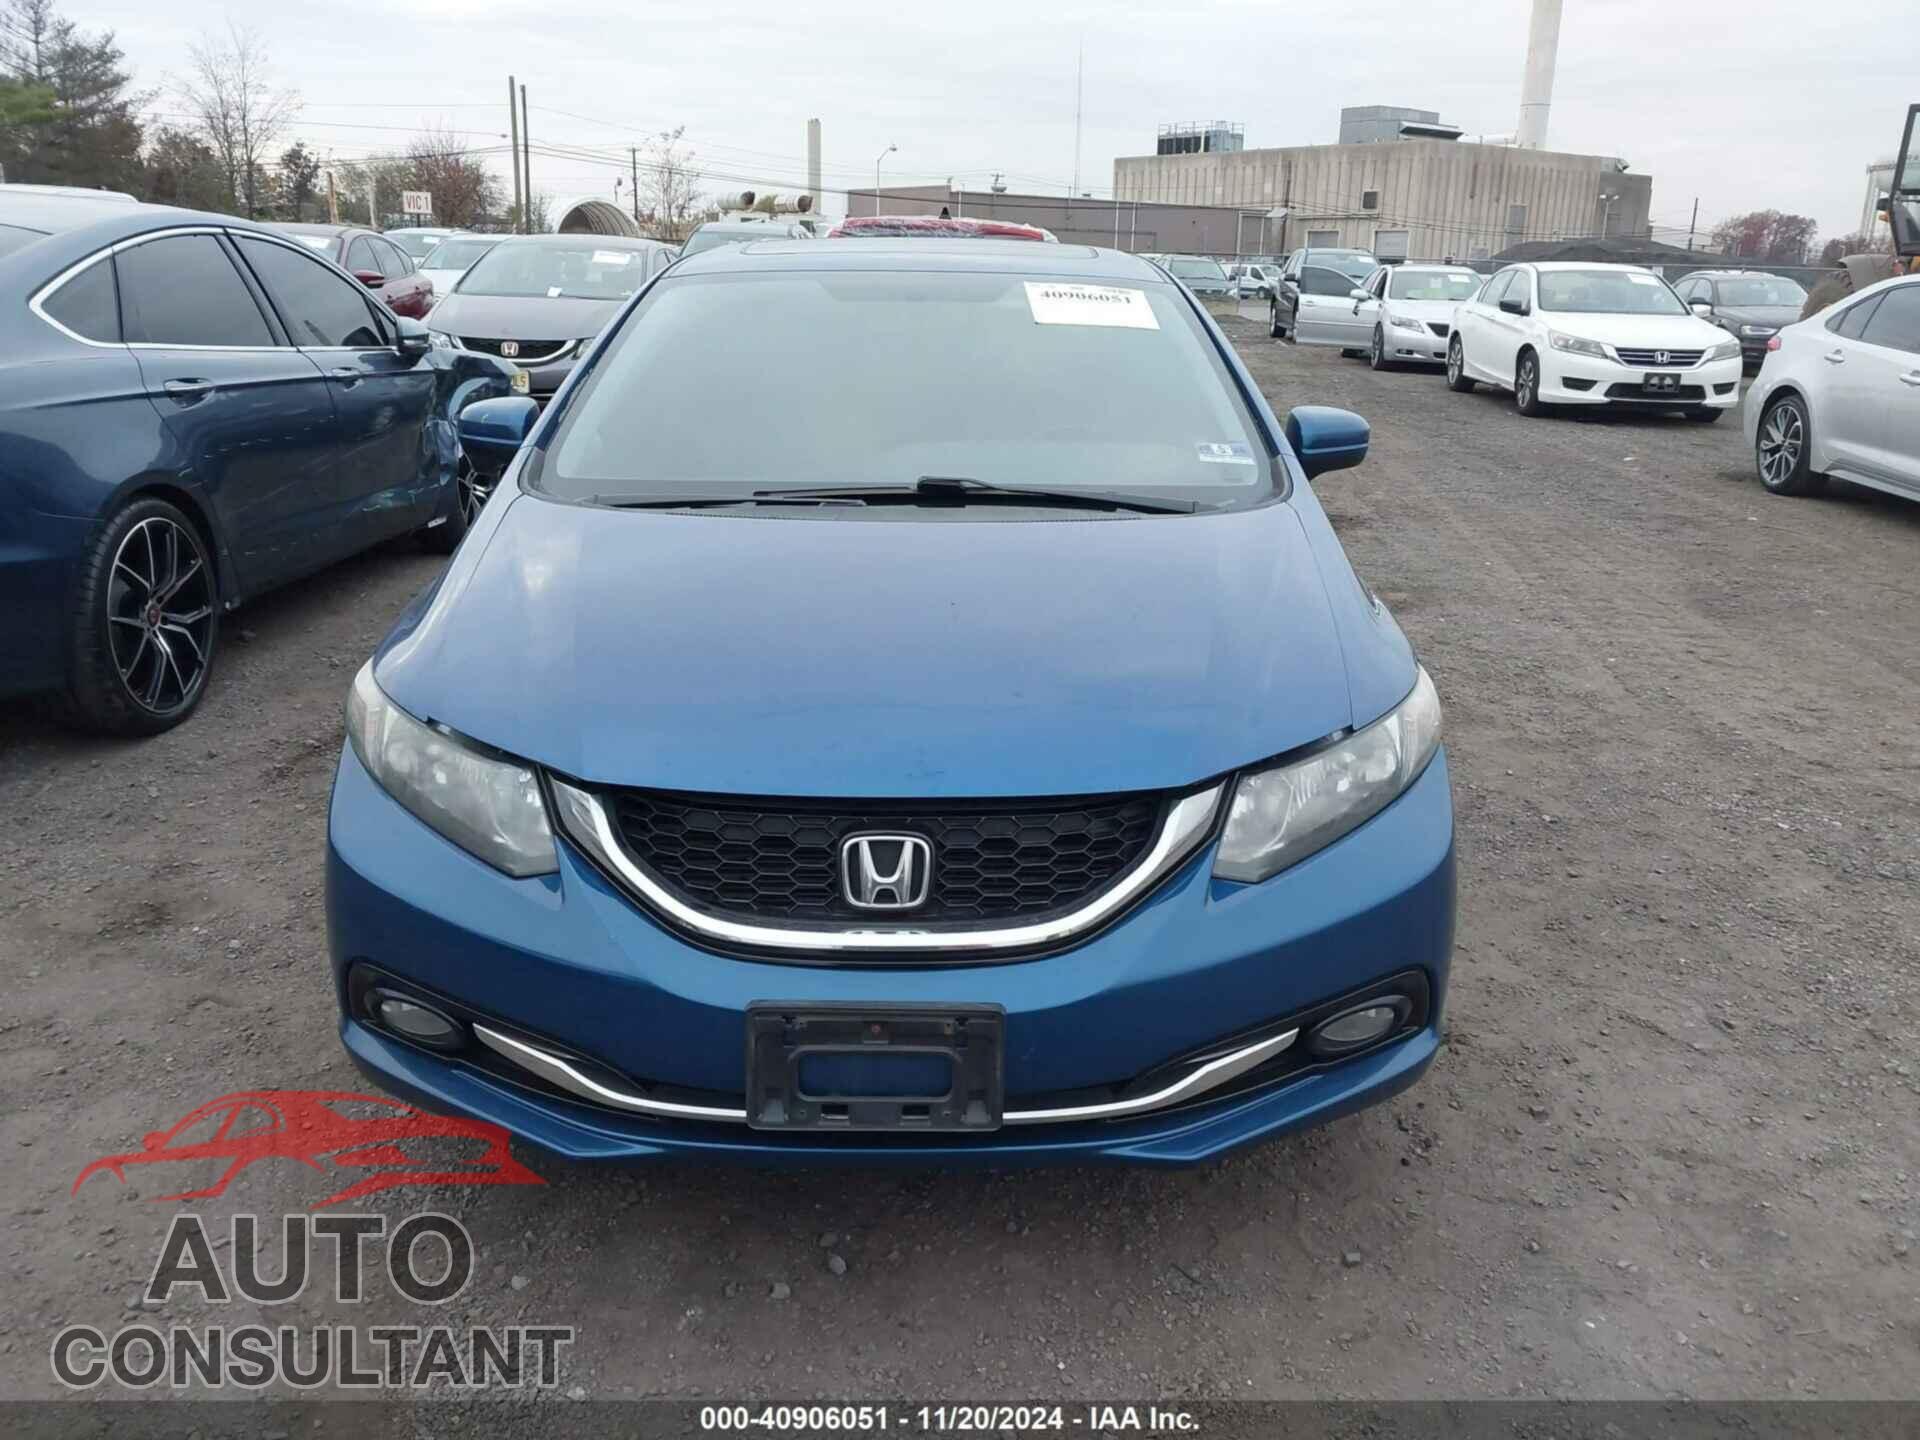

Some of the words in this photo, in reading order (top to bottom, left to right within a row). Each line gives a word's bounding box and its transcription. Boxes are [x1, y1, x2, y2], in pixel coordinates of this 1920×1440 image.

[406, 194, 422, 210] VIC
[424, 195, 430, 210] 1
[1040, 289, 1132, 305] 40906051
